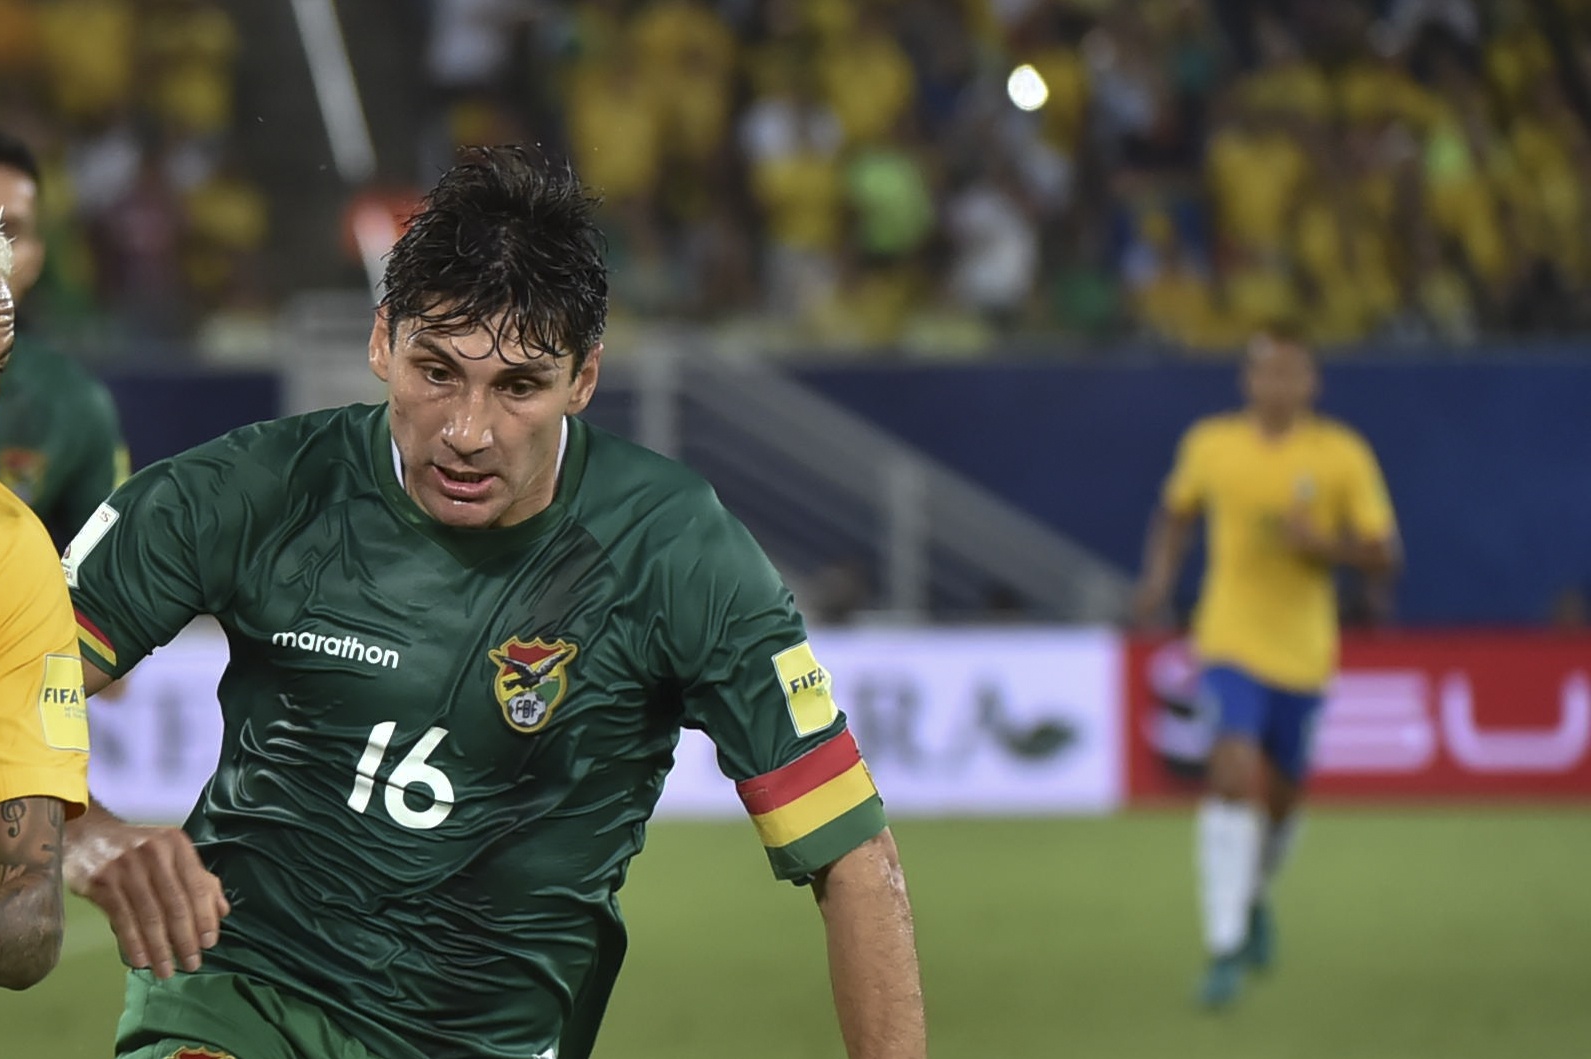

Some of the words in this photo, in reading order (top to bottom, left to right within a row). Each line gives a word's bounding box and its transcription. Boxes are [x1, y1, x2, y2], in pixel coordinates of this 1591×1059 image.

[272, 631, 400, 669] marathon
[789, 667, 826, 694] FIFA
[43, 687, 80, 704] FIFA
[515, 700, 539, 719] FBF
[347, 720, 455, 829] 16
